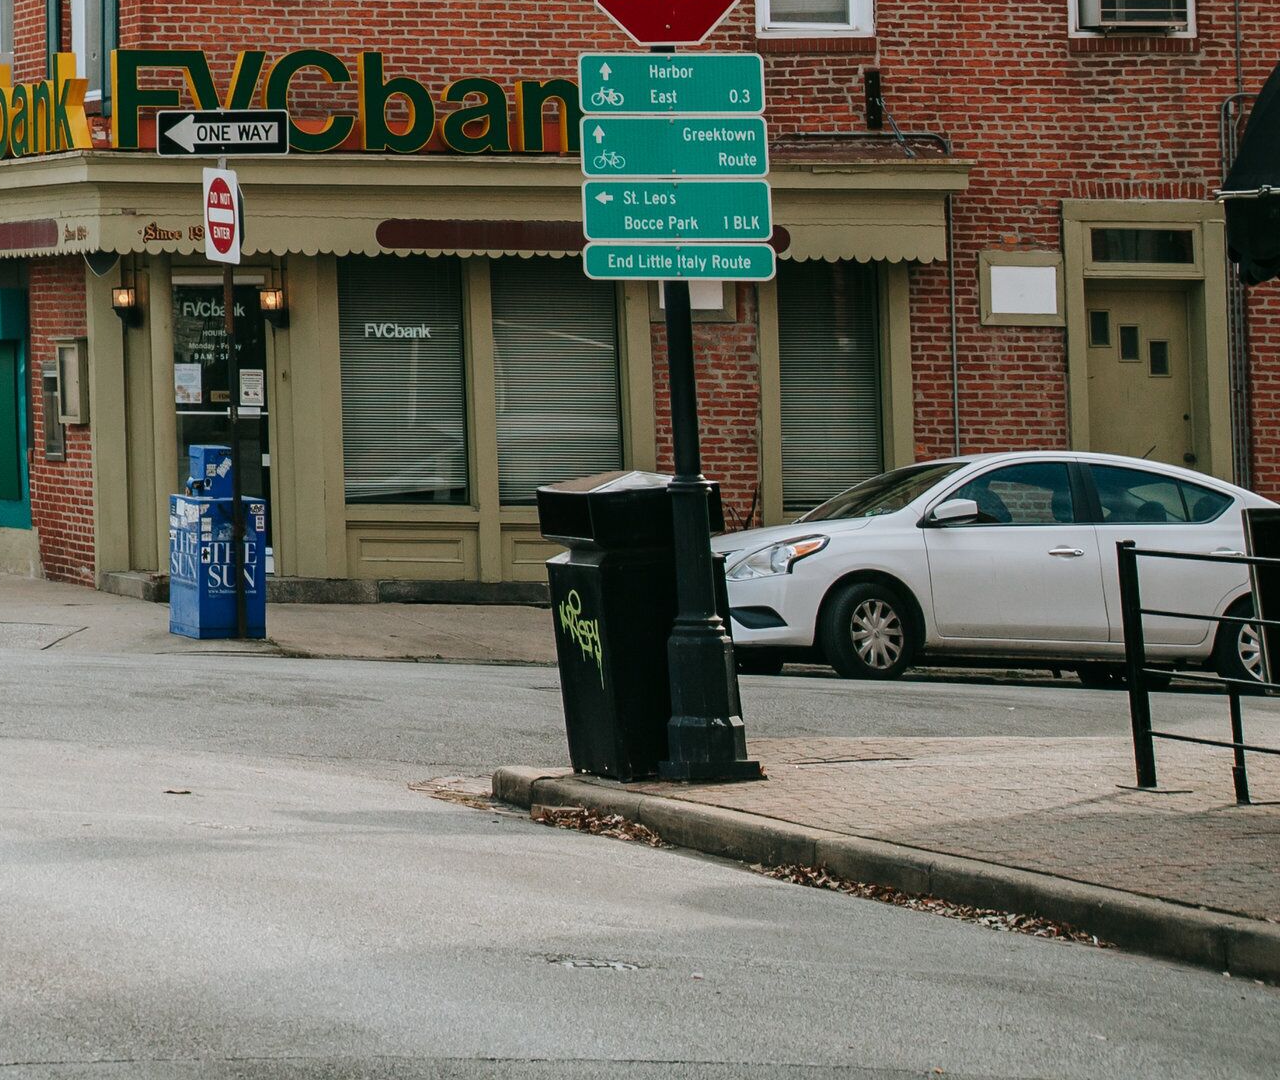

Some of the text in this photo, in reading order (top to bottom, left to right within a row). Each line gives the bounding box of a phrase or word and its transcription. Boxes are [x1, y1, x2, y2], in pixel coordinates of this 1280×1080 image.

[649, 64, 694, 79] Harbor
[110, 48, 581, 154] FVCban
[650, 89, 751, 104] East 0.3
[196, 124, 273, 142] ONE WAY
[682, 127, 756, 142] Greektown
[719, 152, 758, 167] Route
[209, 191, 231, 206] DO NOT
[623, 190, 677, 205] St. Leo's
[624, 215, 760, 230] Bocce Park 1 BLK
[143, 221, 205, 243] Since 19
[213, 226, 231, 240] ENTER
[608, 253, 752, 272] End Little Italy Route
[183, 299, 245, 317] FVCbak
[202, 329, 228, 337] HOURS
[364, 323, 432, 338] FVCbank
[189, 342, 215, 351] Monday
[171, 552, 197, 580] SUN
[208, 565, 257, 588] SUN
